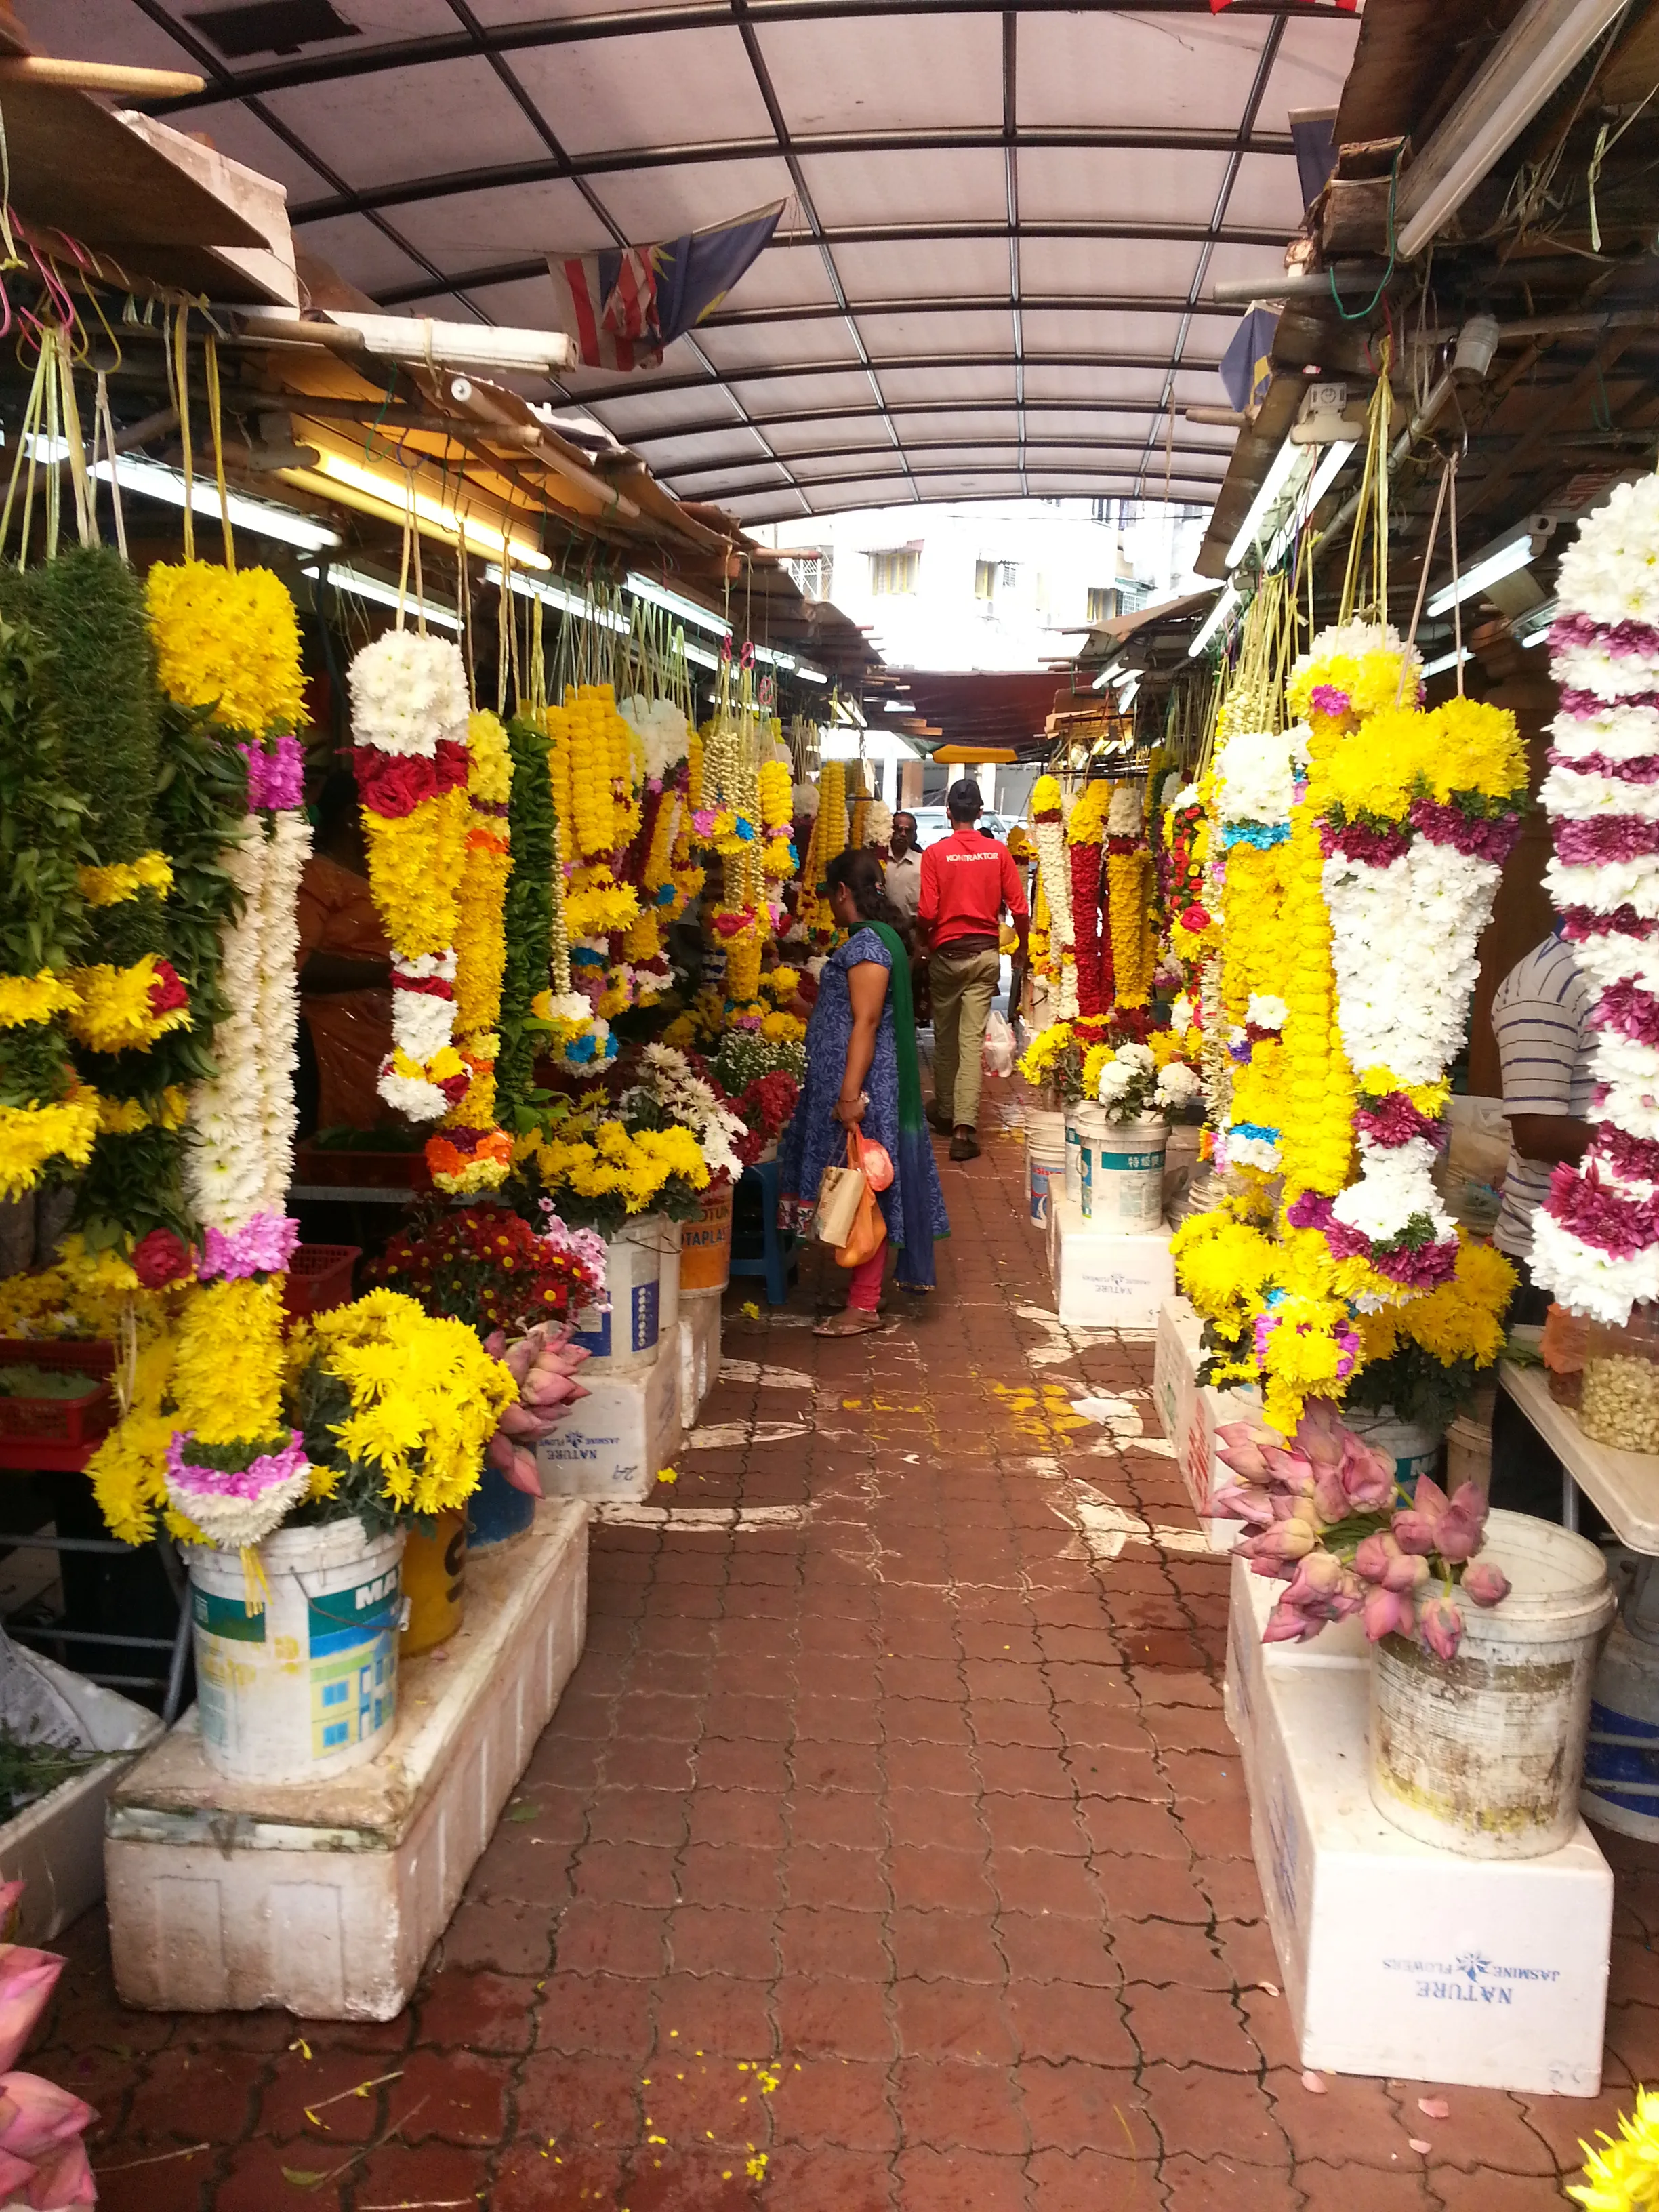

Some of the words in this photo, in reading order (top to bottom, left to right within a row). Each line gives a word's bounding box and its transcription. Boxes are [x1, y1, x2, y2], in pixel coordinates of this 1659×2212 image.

[946, 853, 998, 862] KONTRAKTOR
[1095, 1284, 1132, 1295] NATURE
[546, 1450, 597, 1460] NATURE
[1382, 1959, 1452, 1975] FLOWERS
[1492, 1966, 1561, 1982] JASMINE
[1415, 1980, 1513, 2005] NATURE
